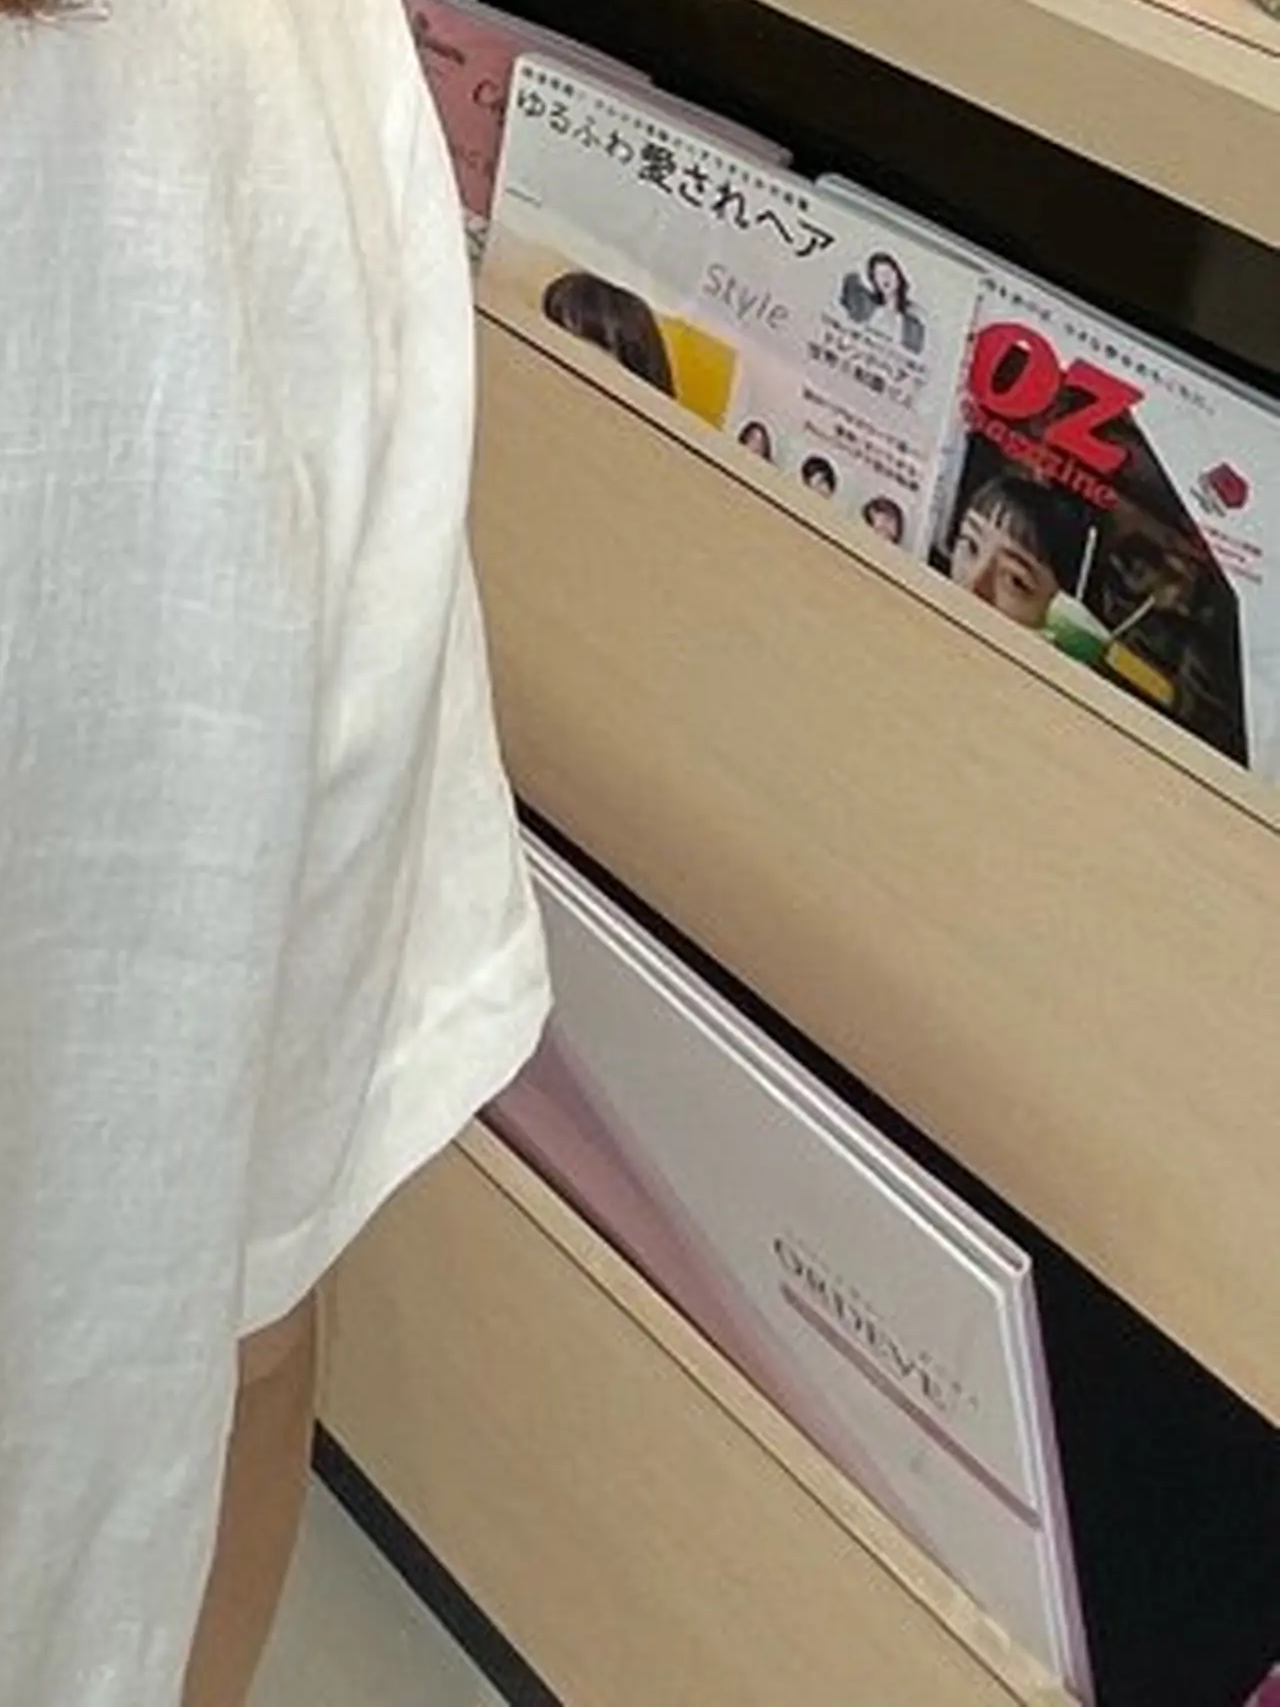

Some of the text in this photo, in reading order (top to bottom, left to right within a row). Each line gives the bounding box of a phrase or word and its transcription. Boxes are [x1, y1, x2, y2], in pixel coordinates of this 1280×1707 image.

[516, 87, 836, 258] ゆるふわ愛されヘア
[702, 261, 791, 331] Style
[959, 398, 1119, 511] magazine
[968, 322, 1146, 474] OZ
